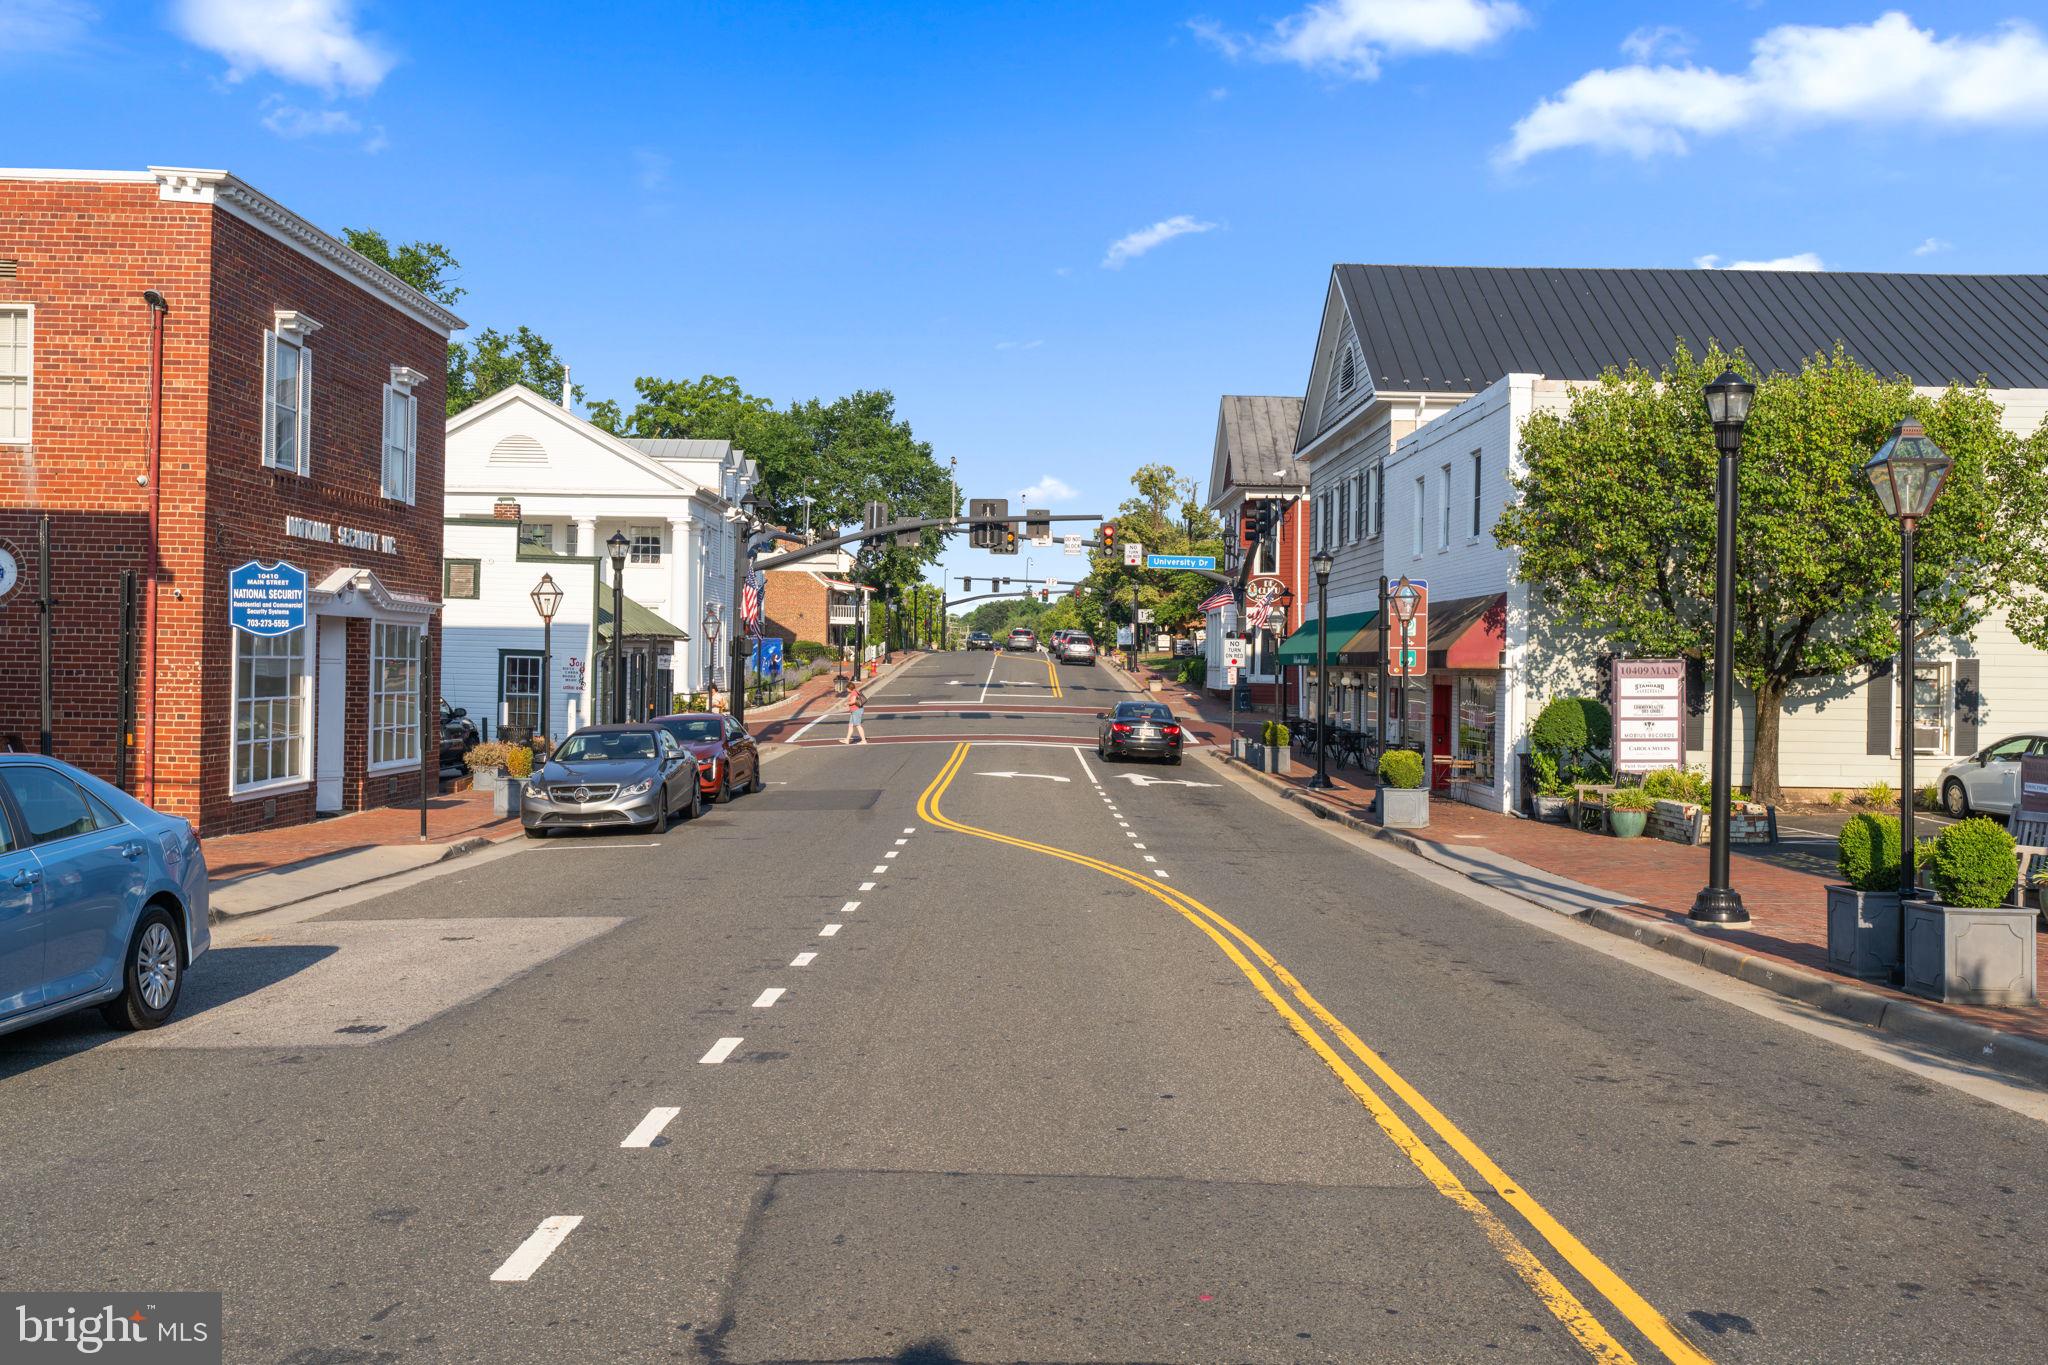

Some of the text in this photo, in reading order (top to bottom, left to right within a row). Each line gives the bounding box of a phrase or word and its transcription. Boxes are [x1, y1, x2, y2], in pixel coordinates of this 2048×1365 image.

[1153, 558, 1209, 567] University Dr
[233, 589, 303, 600] NATIONAL SECURITY
[247, 619, 289, 628] 703-273-5555
[1620, 666, 1679, 675] 10409 MAIN
[1634, 683, 1665, 691] STANDARD
